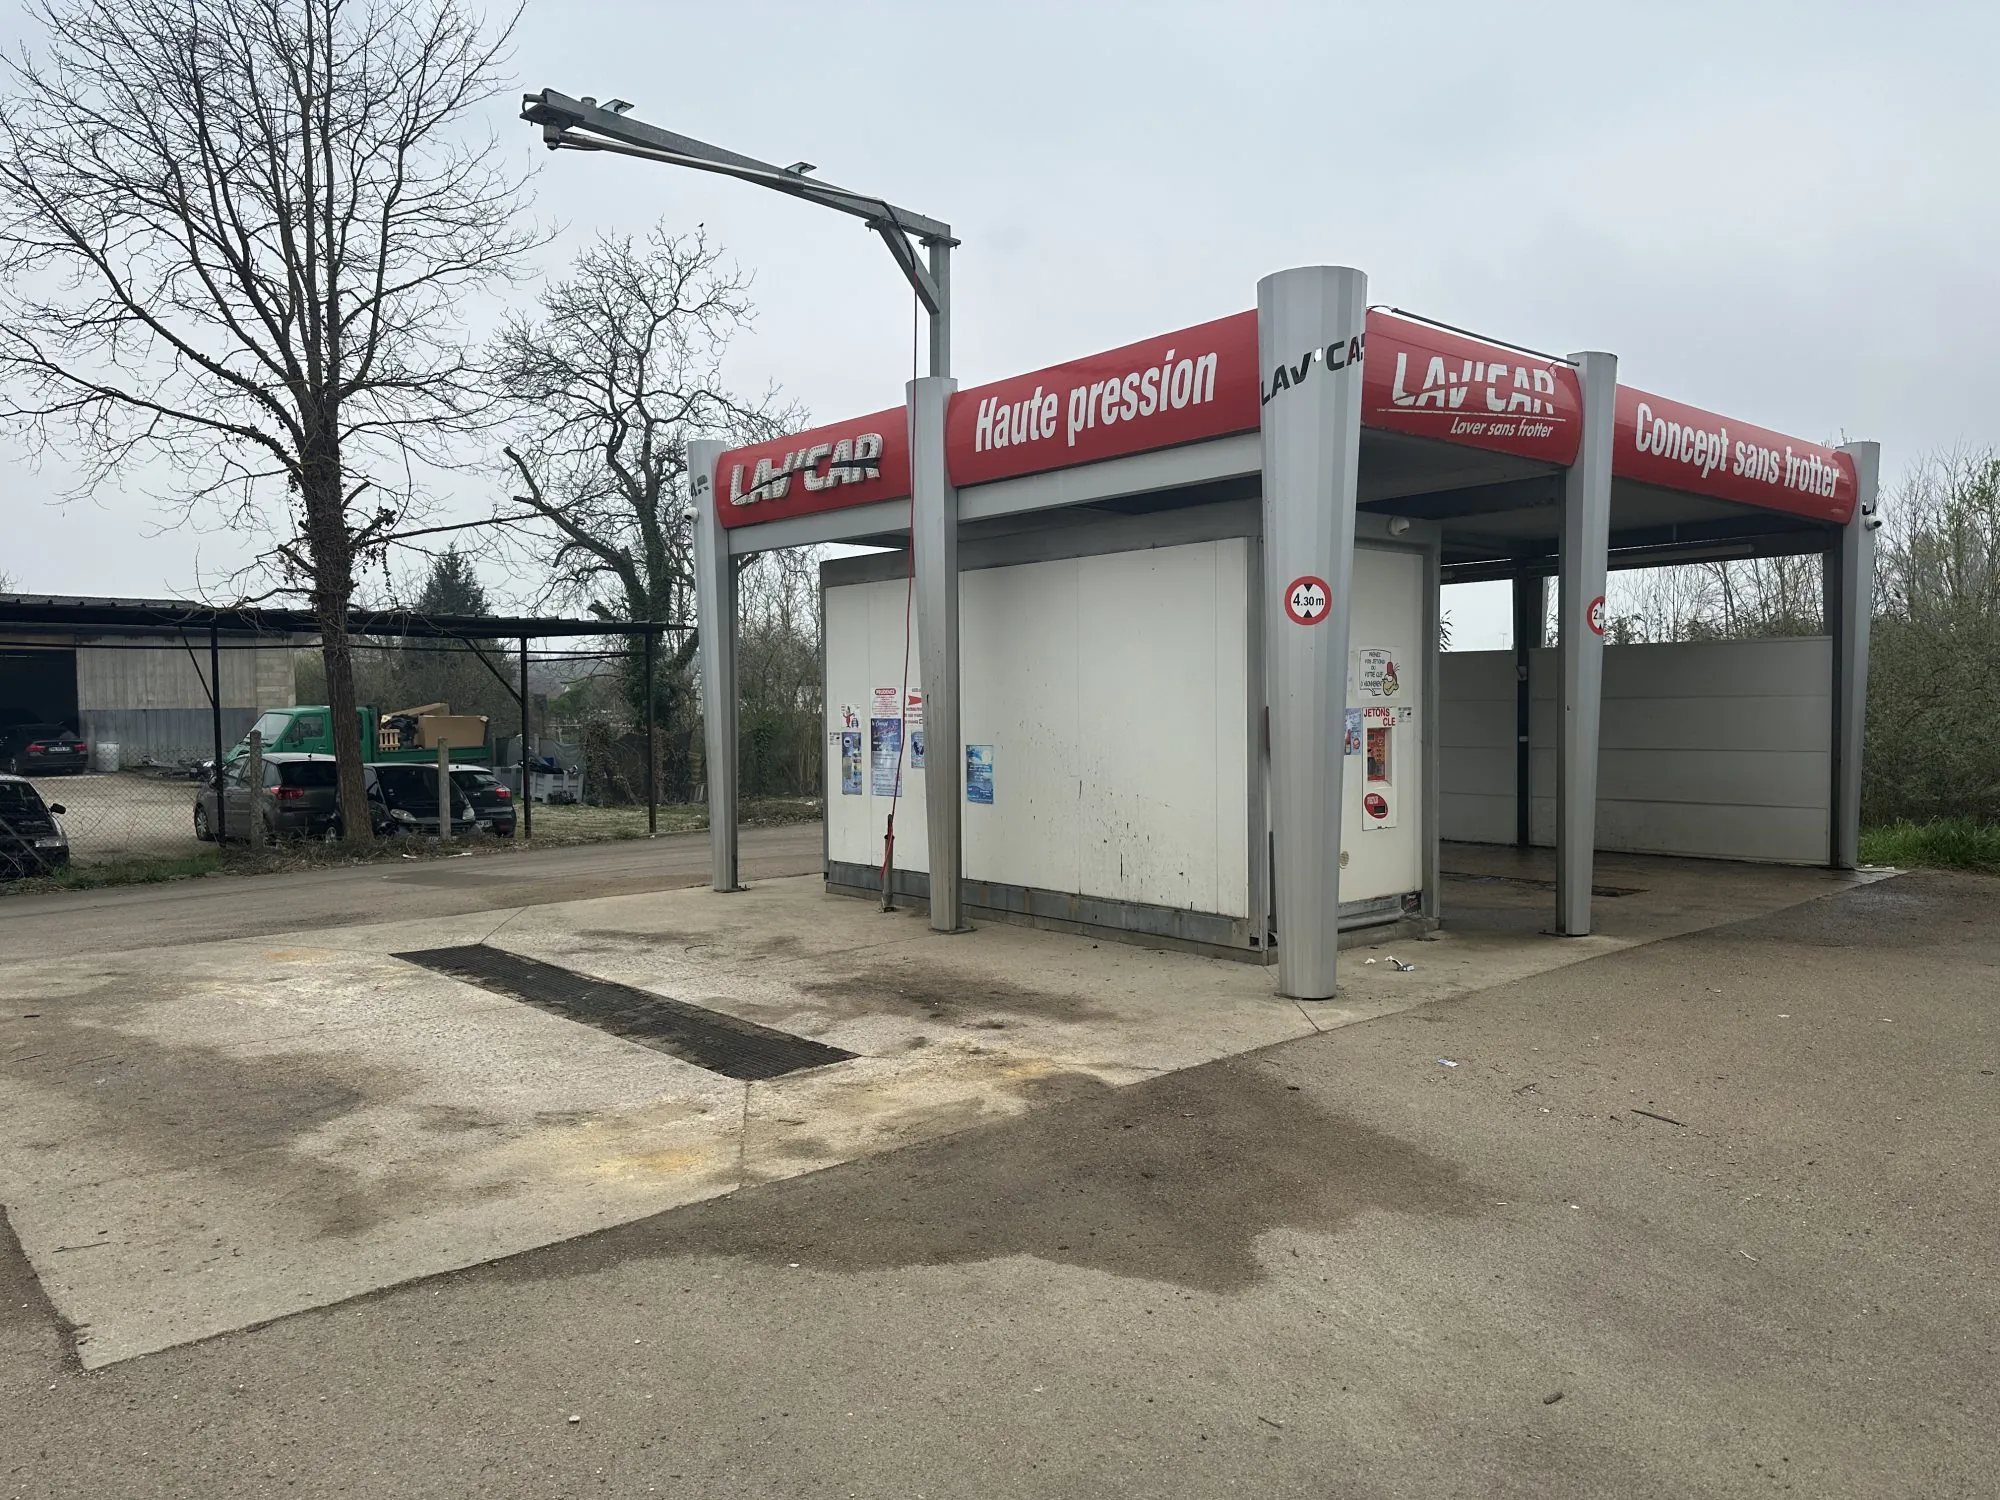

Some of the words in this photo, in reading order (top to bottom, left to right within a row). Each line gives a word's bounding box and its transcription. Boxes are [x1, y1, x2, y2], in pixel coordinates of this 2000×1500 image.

[975, 386, 1058, 452] Haute
[1067, 349, 1217, 447] pression
[1450, 416, 1487, 435] Laver
[1487, 422, 1515, 436] sans
[1517, 418, 1553, 438] frotter
[1635, 402, 1729, 478] Concept
[1732, 440, 1780, 484] sans
[1784, 445, 1840, 498] frotter
[1364, 708, 1390, 717] JETONS
